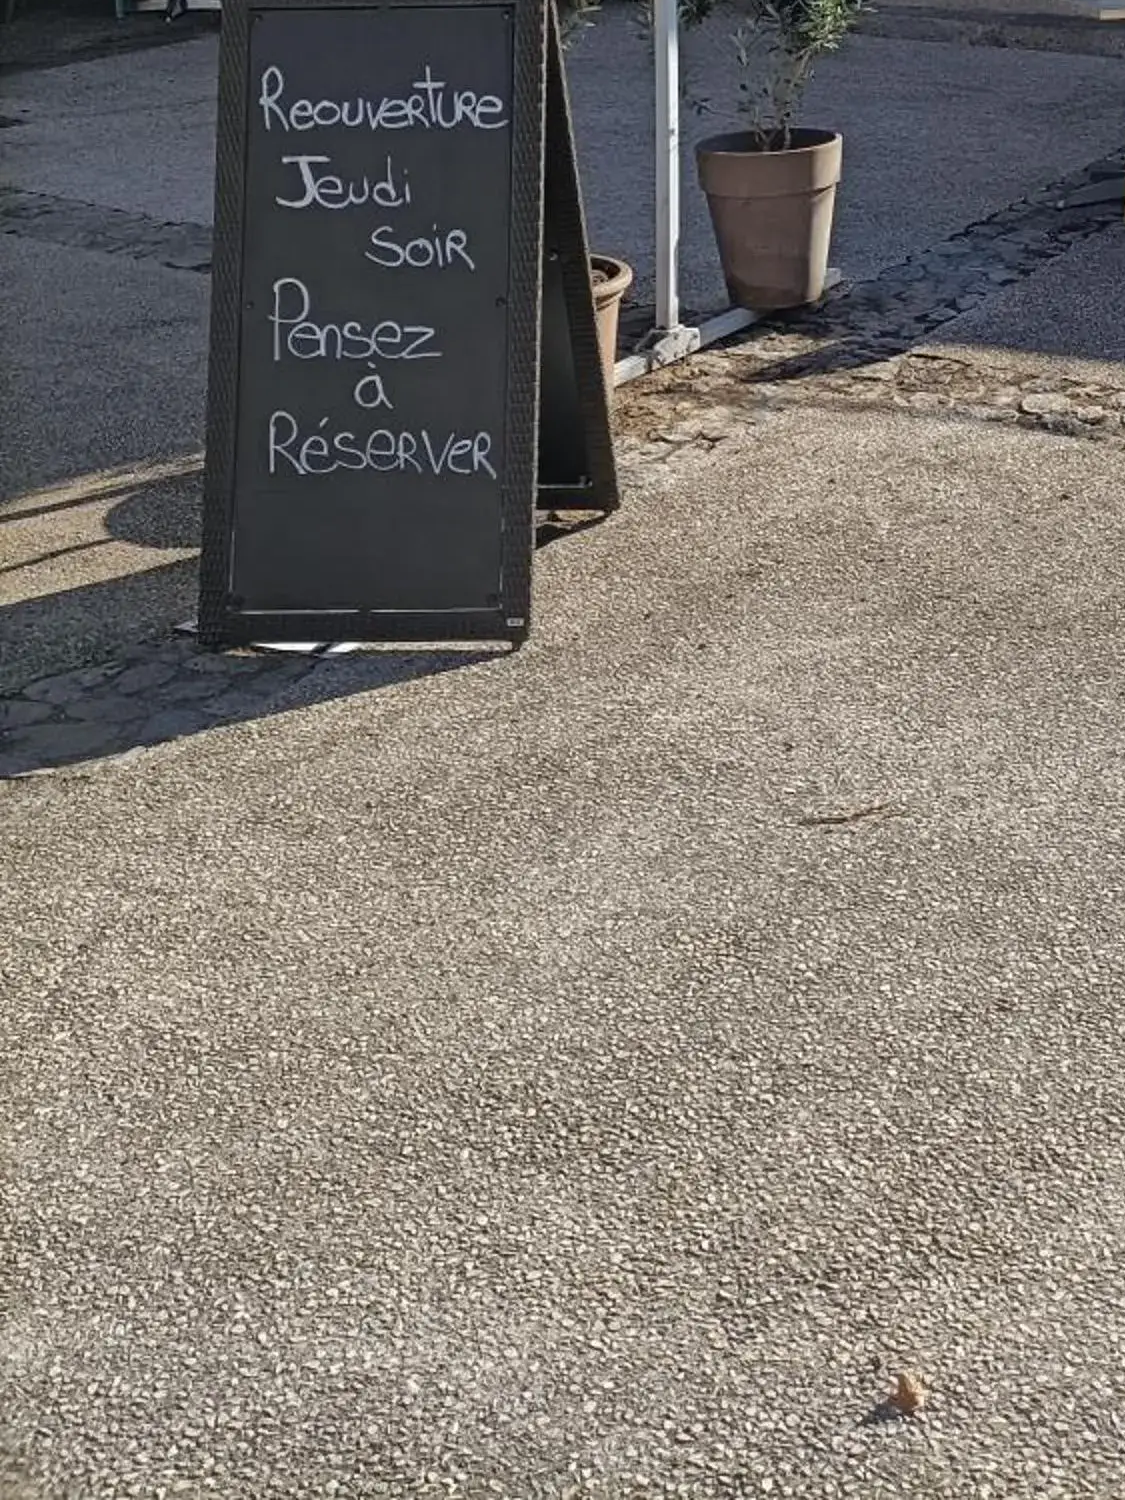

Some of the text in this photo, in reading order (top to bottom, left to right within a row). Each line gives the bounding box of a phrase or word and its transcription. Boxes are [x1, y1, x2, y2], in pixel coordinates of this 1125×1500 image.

[274, 155, 412, 210] Jeudi
[268, 277, 443, 361] Pensez
[353, 361, 394, 410] à
